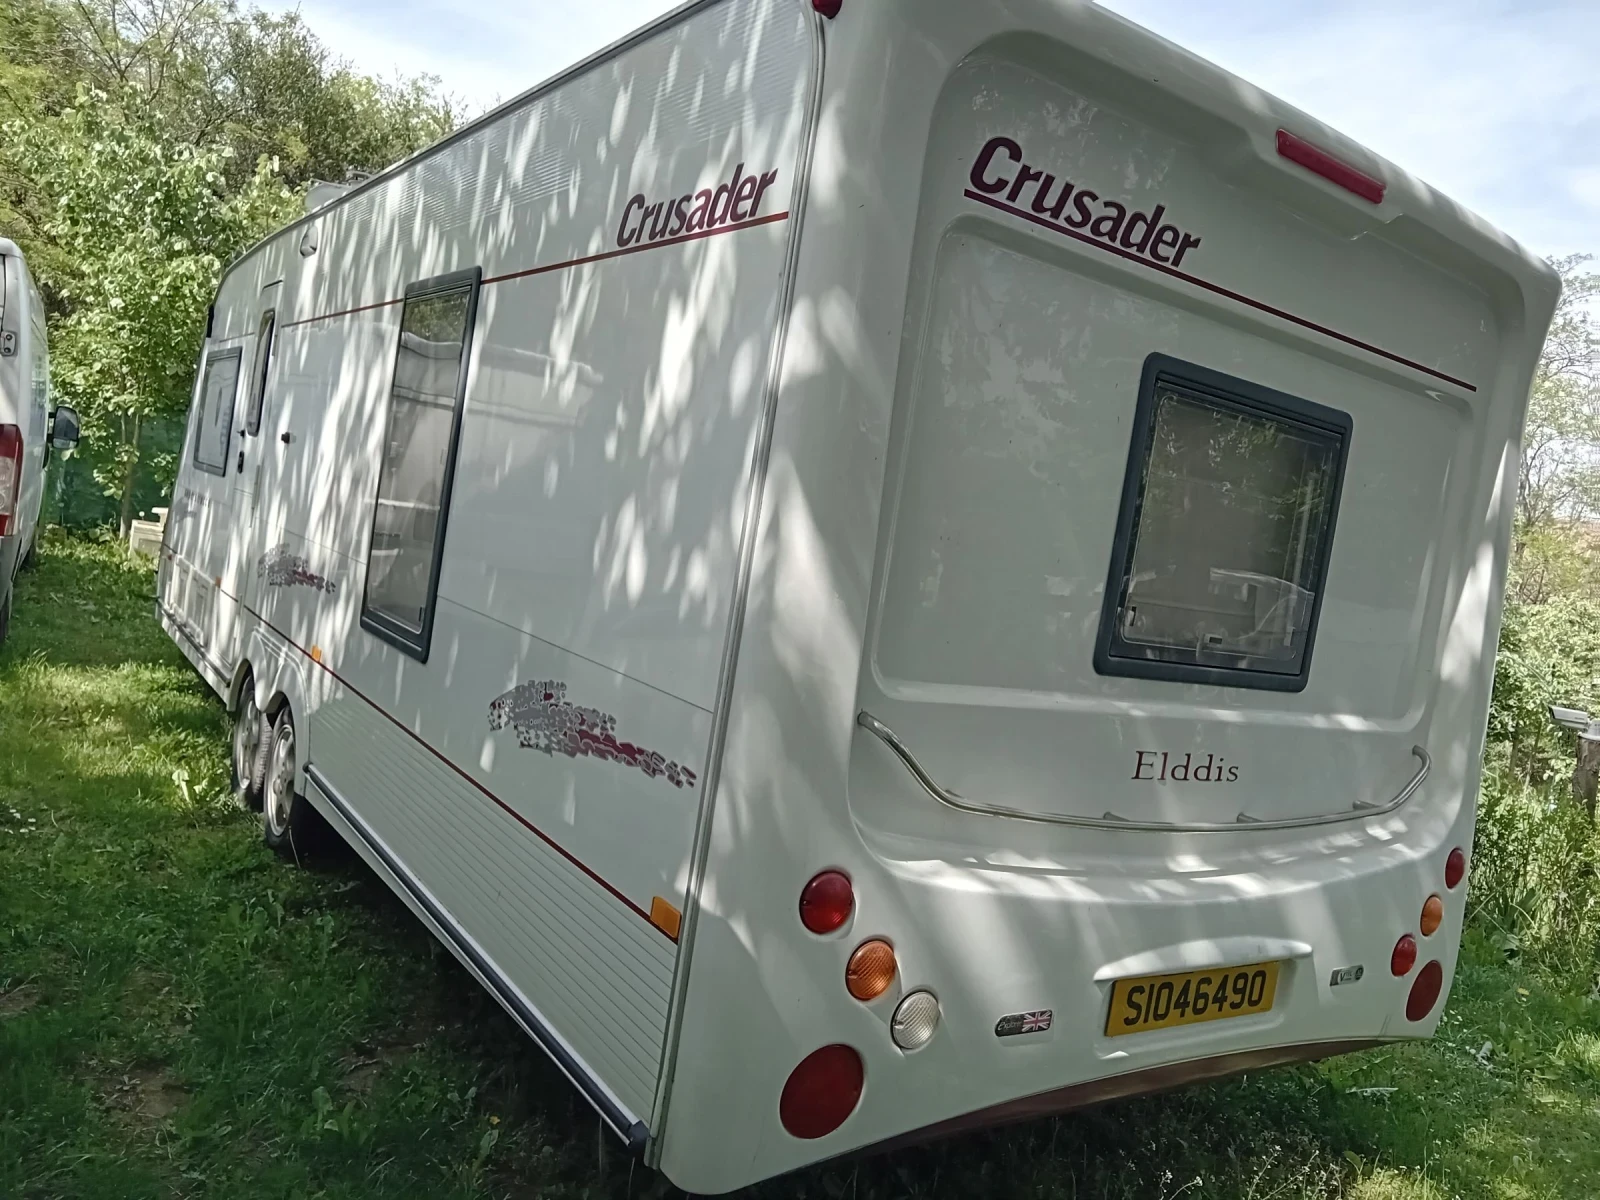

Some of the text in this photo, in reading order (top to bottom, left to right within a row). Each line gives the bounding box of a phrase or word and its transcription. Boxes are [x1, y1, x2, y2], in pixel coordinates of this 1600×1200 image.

[617, 162, 778, 247] Crusader
[970, 136, 1201, 268] Crusader
[1131, 751, 1239, 782] Elddis
